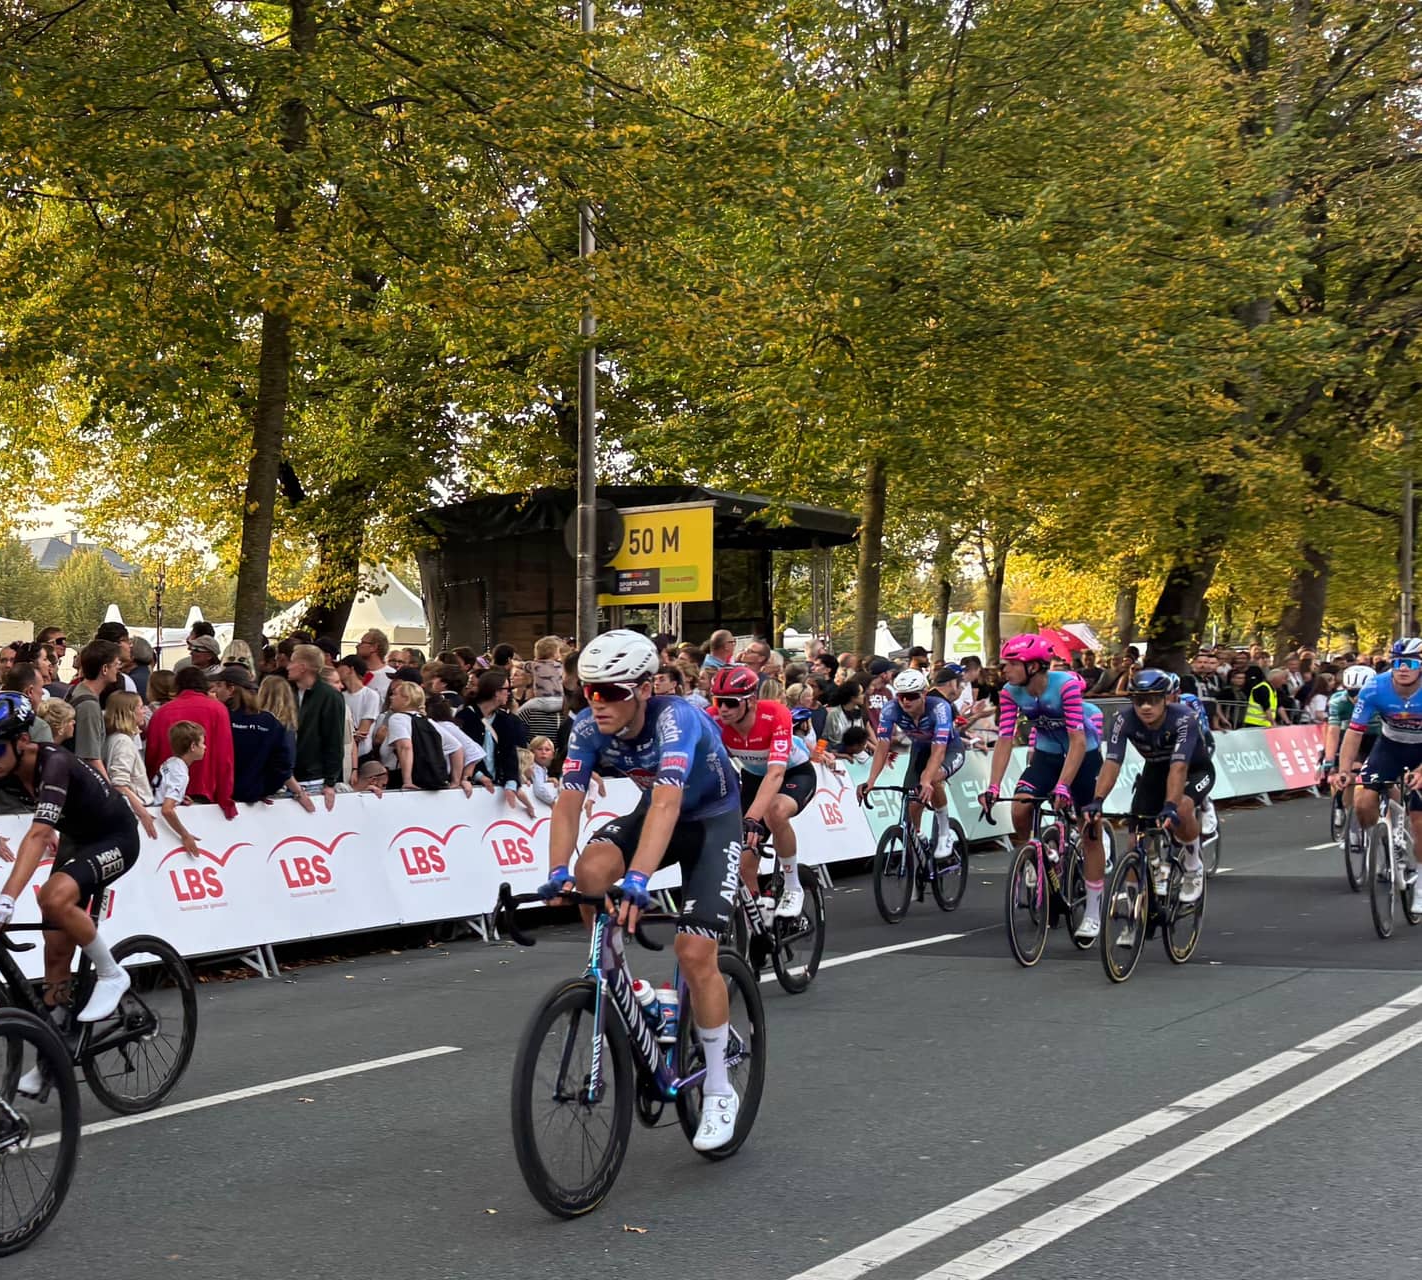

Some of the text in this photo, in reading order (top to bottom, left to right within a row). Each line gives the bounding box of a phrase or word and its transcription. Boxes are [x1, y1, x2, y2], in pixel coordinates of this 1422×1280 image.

[628, 525, 680, 555] 50 M
[819, 802, 844, 826] LBS
[96, 847, 122, 866] MRW
[399, 844, 446, 876] LBS
[490, 837, 535, 867] LBS
[102, 859, 124, 879] BAU
[169, 866, 224, 902] LBS
[279, 854, 332, 889] LBS
[719, 839, 743, 906] Alpecin
[613, 968, 659, 1075] CANYON
